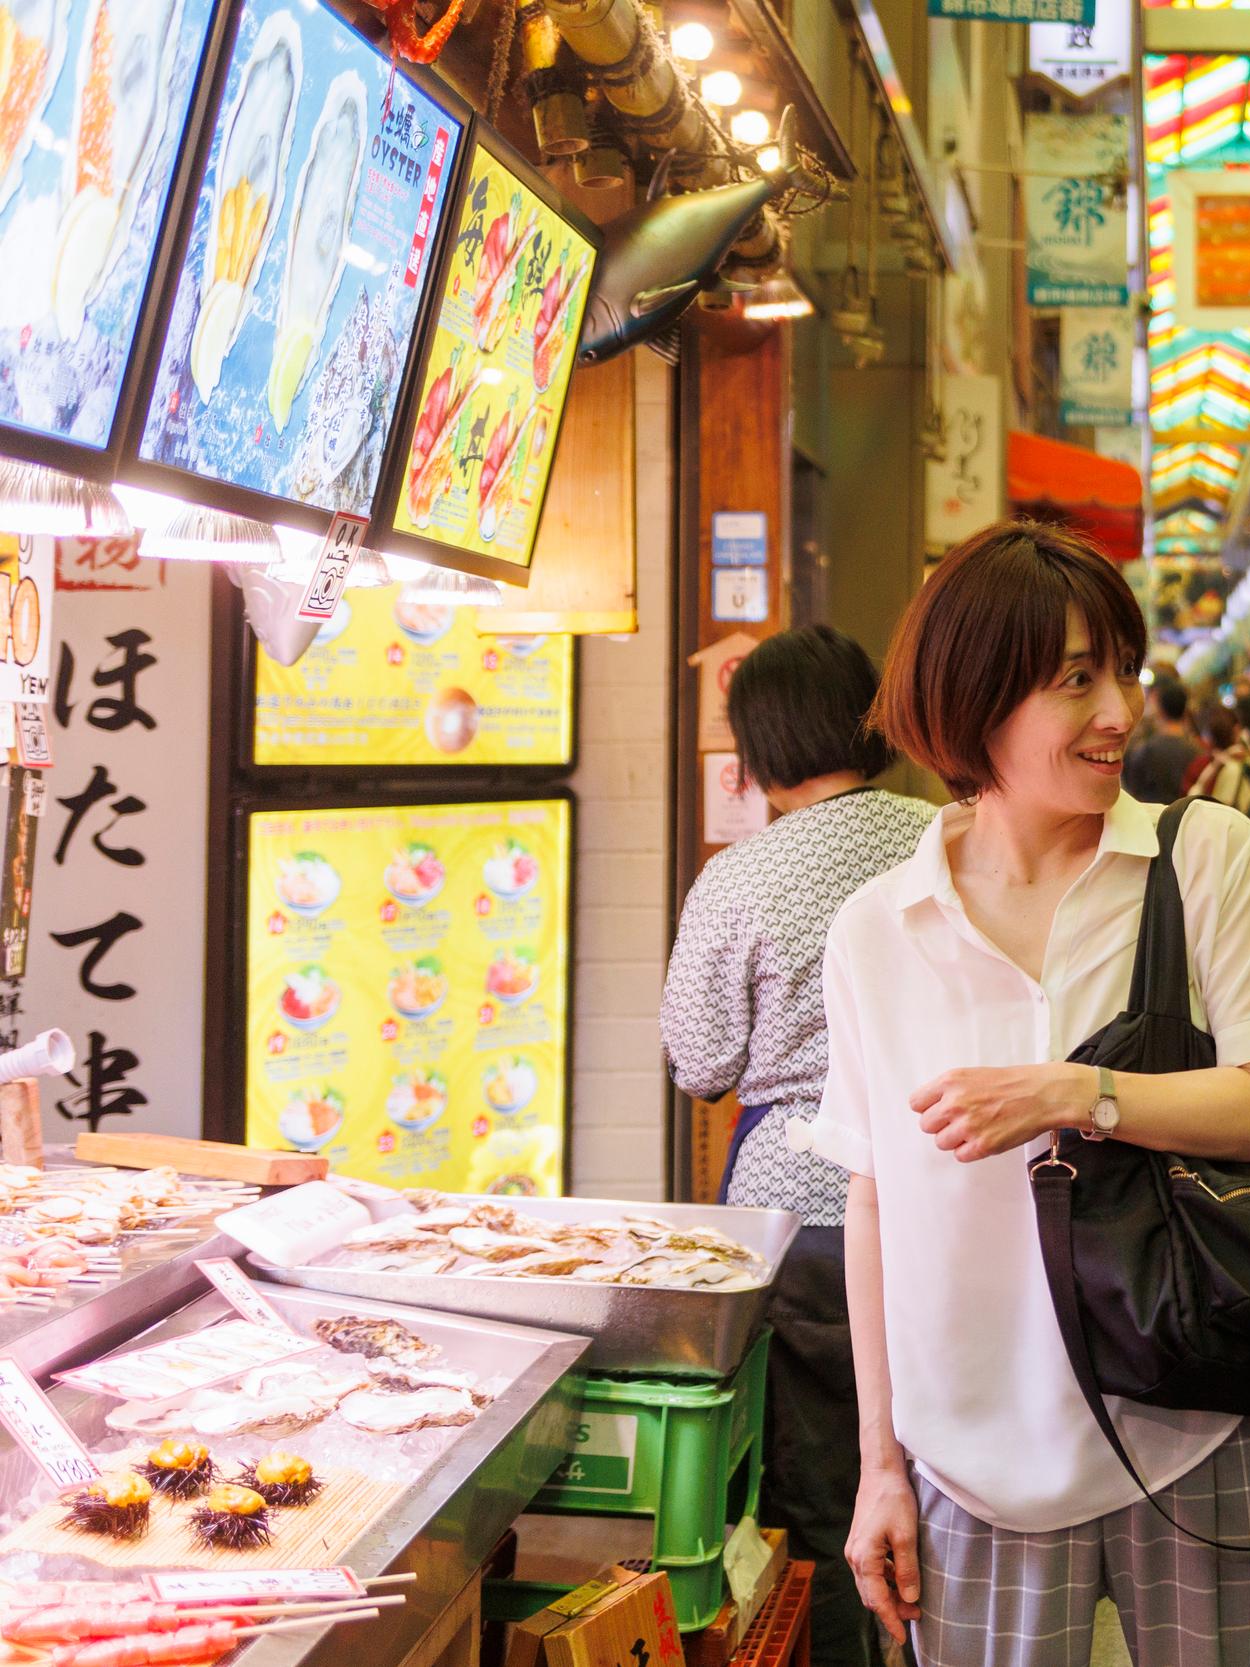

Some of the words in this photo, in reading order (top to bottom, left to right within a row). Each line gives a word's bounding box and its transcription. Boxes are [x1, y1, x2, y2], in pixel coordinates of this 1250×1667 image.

[371, 134, 422, 188] OYSTER
[407, 138, 446, 274] 産地直送
[453, 176, 489, 276] 海
[458, 402, 491, 495] 丼
[335, 522, 360, 549] OK
[20, 673, 49, 696] YEN
[49, 628, 158, 1132] ほたて串
